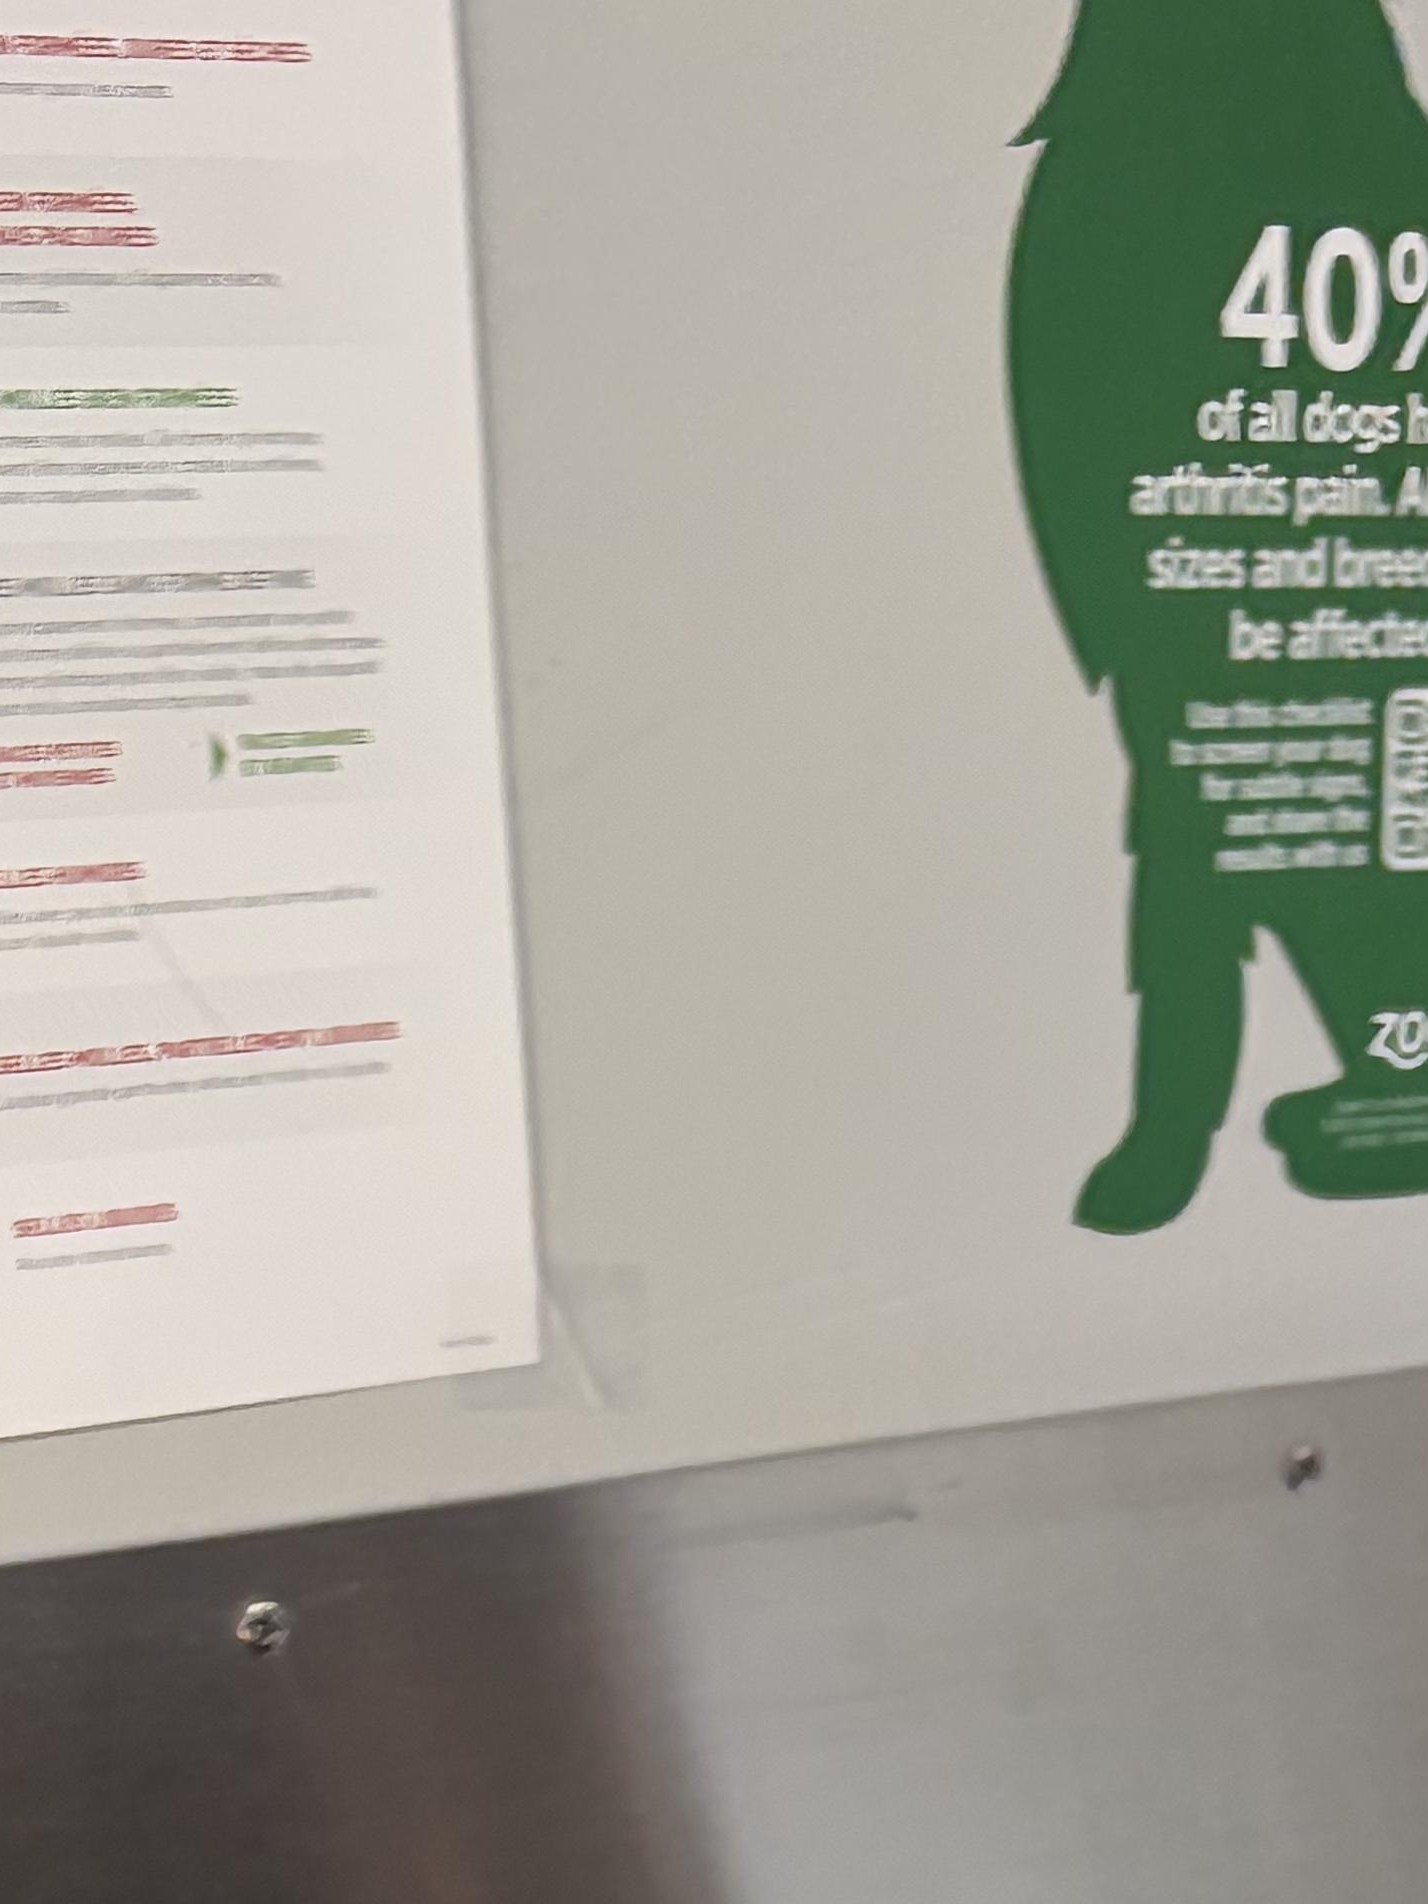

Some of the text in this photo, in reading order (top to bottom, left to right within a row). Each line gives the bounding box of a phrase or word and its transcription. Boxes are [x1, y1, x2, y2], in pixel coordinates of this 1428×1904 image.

[1196, 388, 1247, 441] of
[1248, 389, 1298, 442] all
[1303, 391, 1401, 453] dogs
[1129, 461, 1289, 516] arthritis
[1292, 464, 1391, 526] pain.
[1146, 535, 1247, 590] sizes
[1250, 536, 1329, 588] and
[1228, 608, 1286, 661] be
